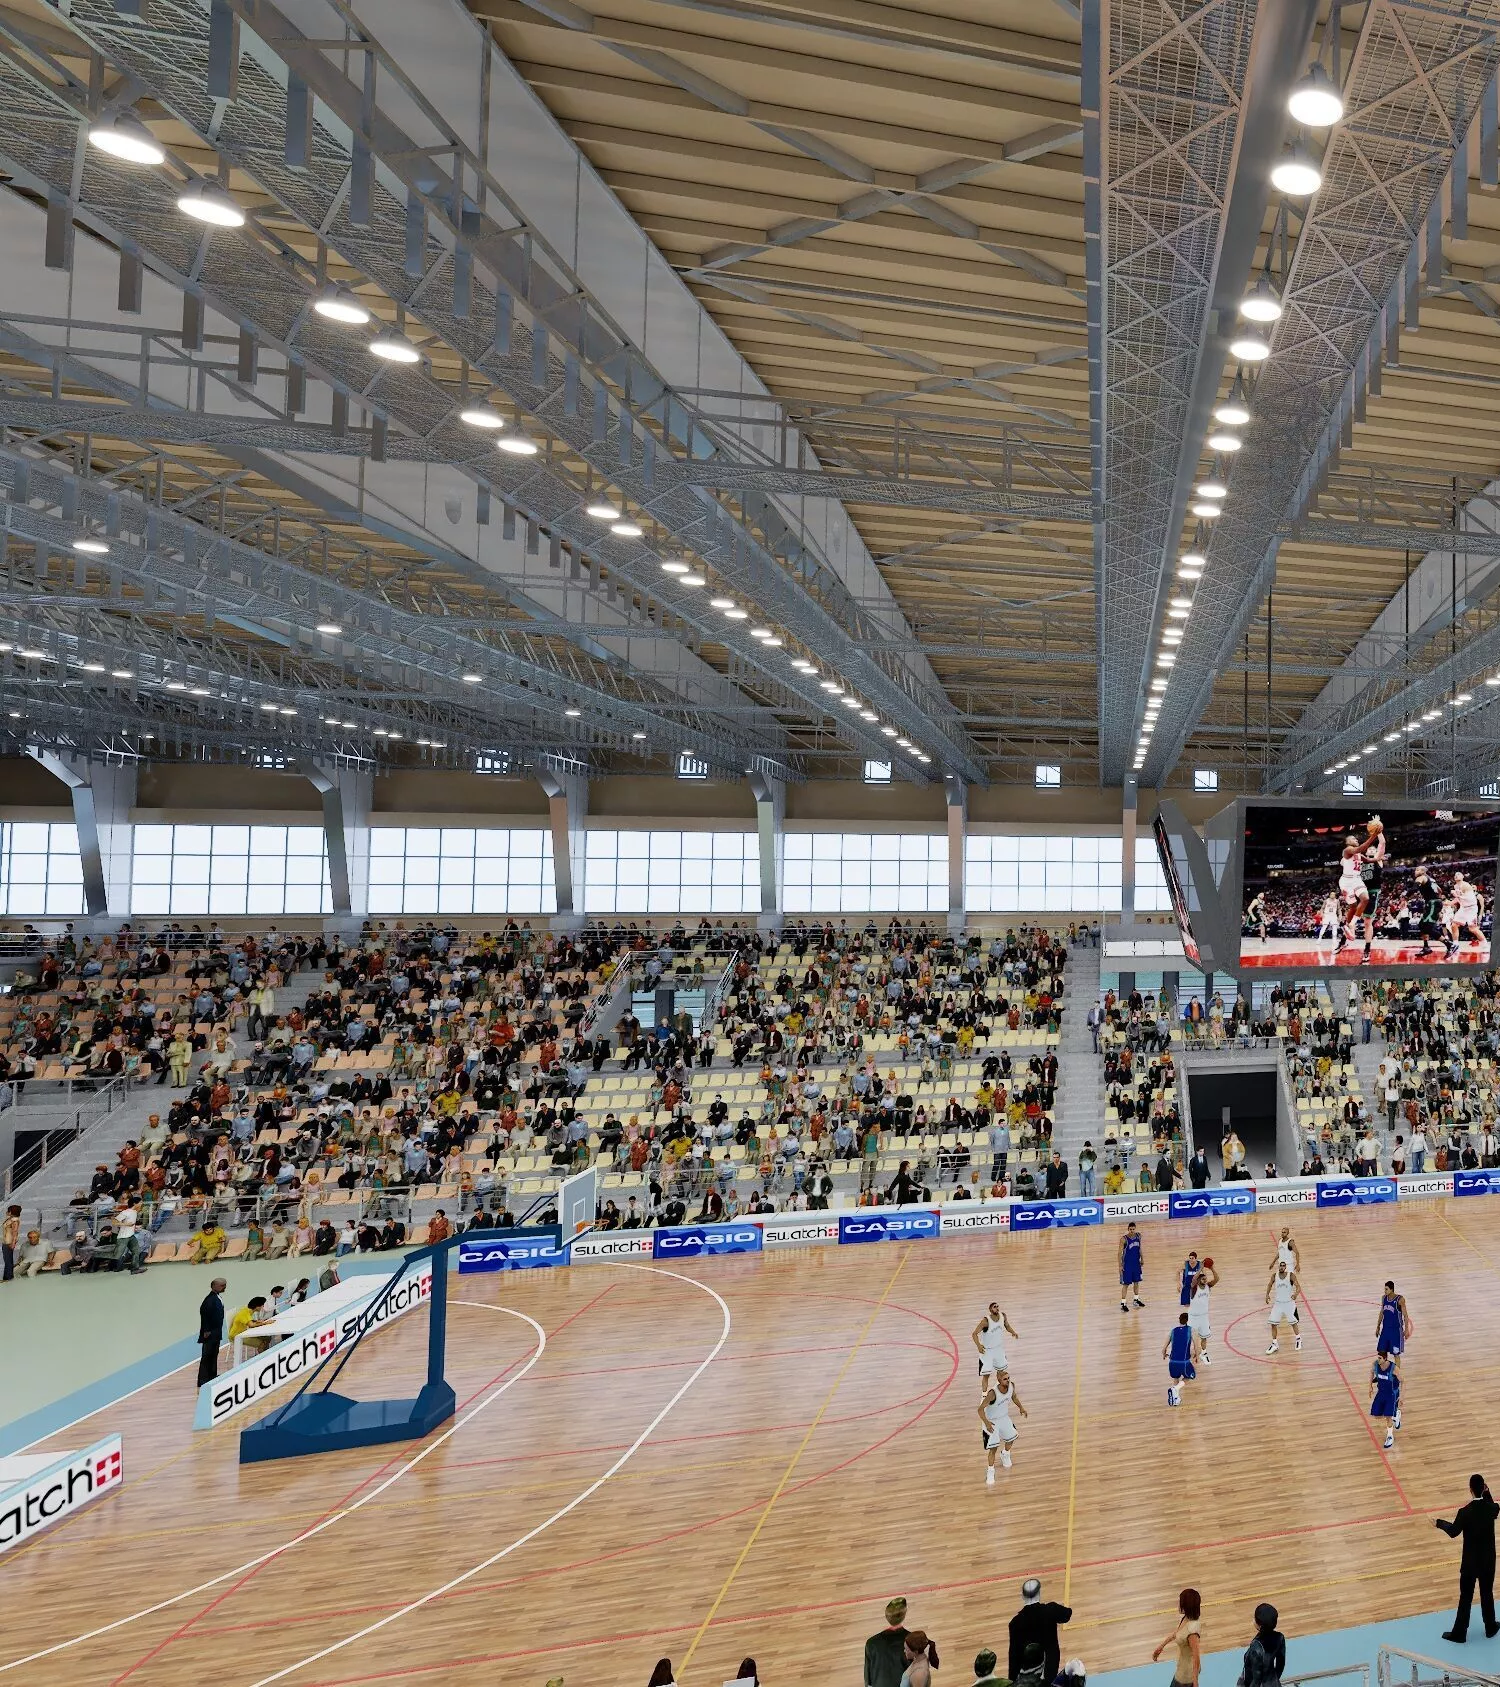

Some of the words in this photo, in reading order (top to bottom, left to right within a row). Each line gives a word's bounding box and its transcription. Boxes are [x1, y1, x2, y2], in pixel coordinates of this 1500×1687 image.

[1321, 1185, 1393, 1199] CASIO
[1399, 1180, 1446, 1194] swatch
[1174, 1195, 1250, 1209] CASIO
[1258, 1190, 1308, 1205] swatch
[1015, 1207, 1098, 1221] CASIO
[1106, 1201, 1160, 1216] swatch
[844, 1219, 934, 1234] CASIO
[943, 1213, 1000, 1229] swatch
[659, 1231, 756, 1248] CASIO
[766, 1226, 828, 1242] swatch
[459, 1246, 563, 1263] CASIO
[574, 1238, 642, 1256] swatch
[213, 1337, 319, 1420] swatch
